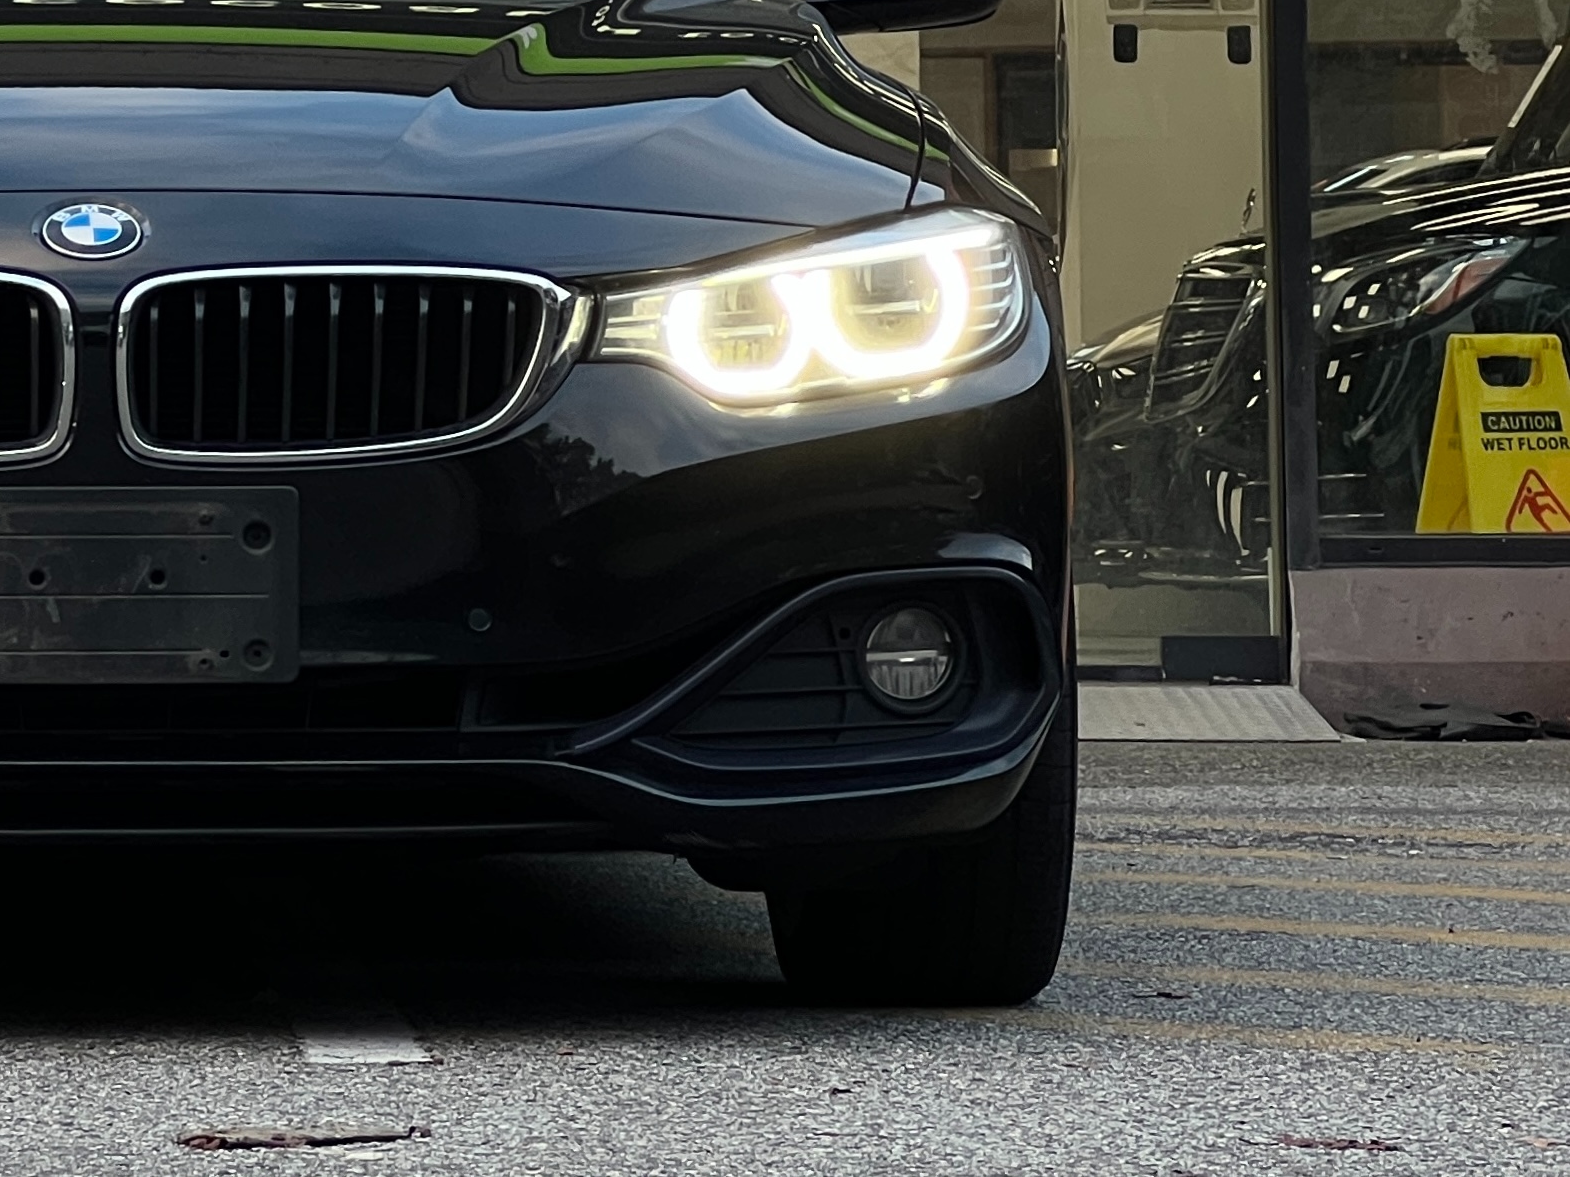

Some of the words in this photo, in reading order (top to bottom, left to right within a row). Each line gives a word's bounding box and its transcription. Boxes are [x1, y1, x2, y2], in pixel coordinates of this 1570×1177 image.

[1487, 415, 1556, 430] CAUTION
[1480, 437, 1514, 451] WET
[1517, 436, 1570, 451] FLOOR
